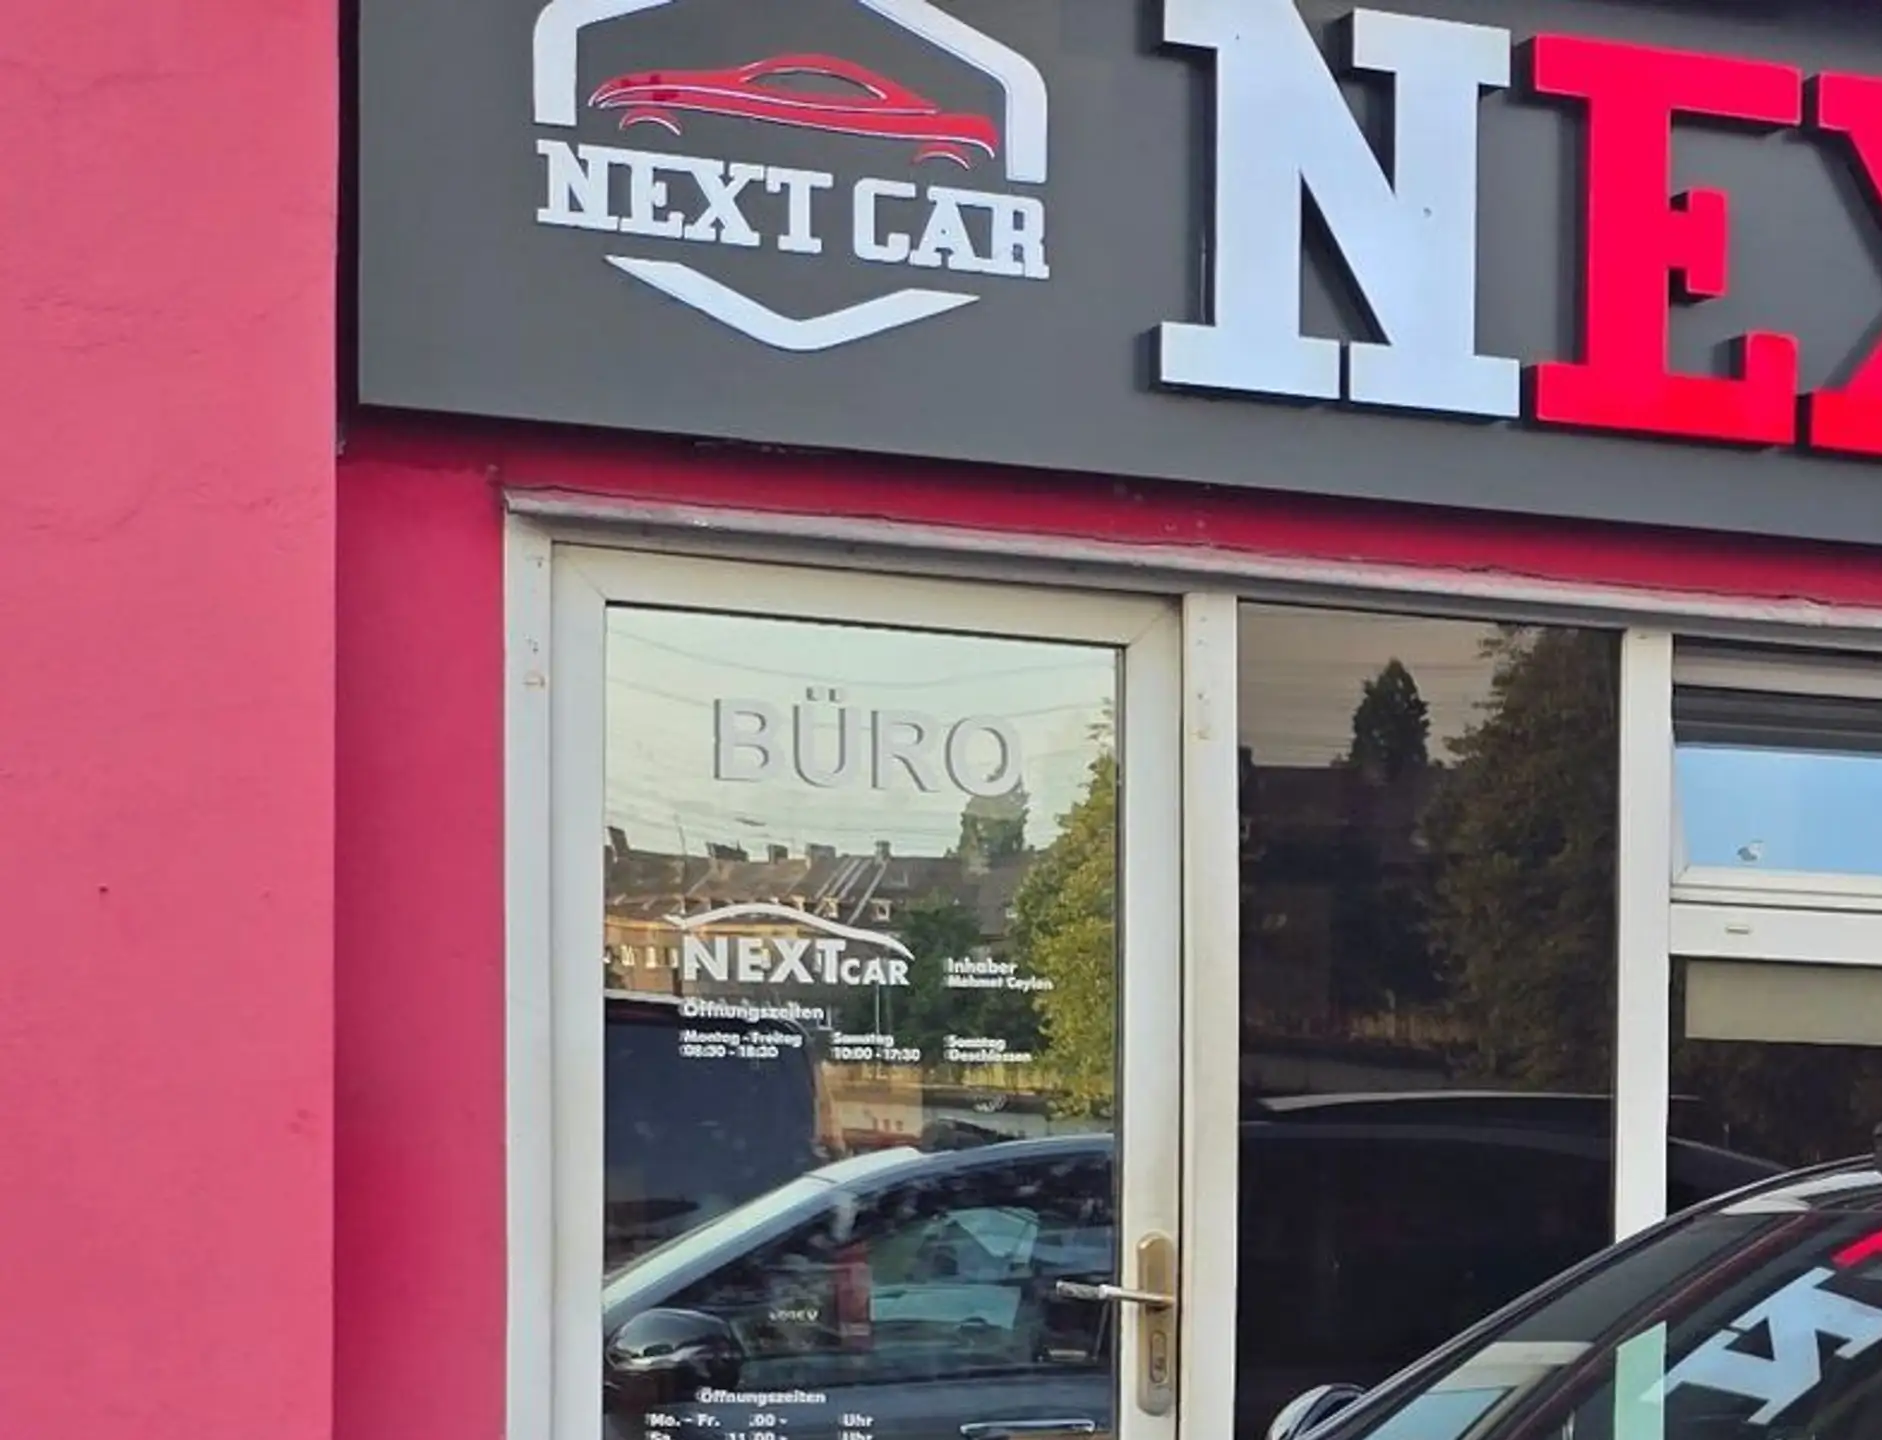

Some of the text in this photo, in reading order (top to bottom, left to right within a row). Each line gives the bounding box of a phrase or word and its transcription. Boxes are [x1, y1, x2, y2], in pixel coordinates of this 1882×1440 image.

[536, 138, 1050, 280] NEXT CAR
[712, 686, 1023, 798] BÜRO
[944, 957, 1018, 975] Inhaber
[696, 1386, 827, 1407] Öffnungszeiten
[697, 1414, 722, 1428] Fr.
[840, 1413, 874, 1427] Uhr
